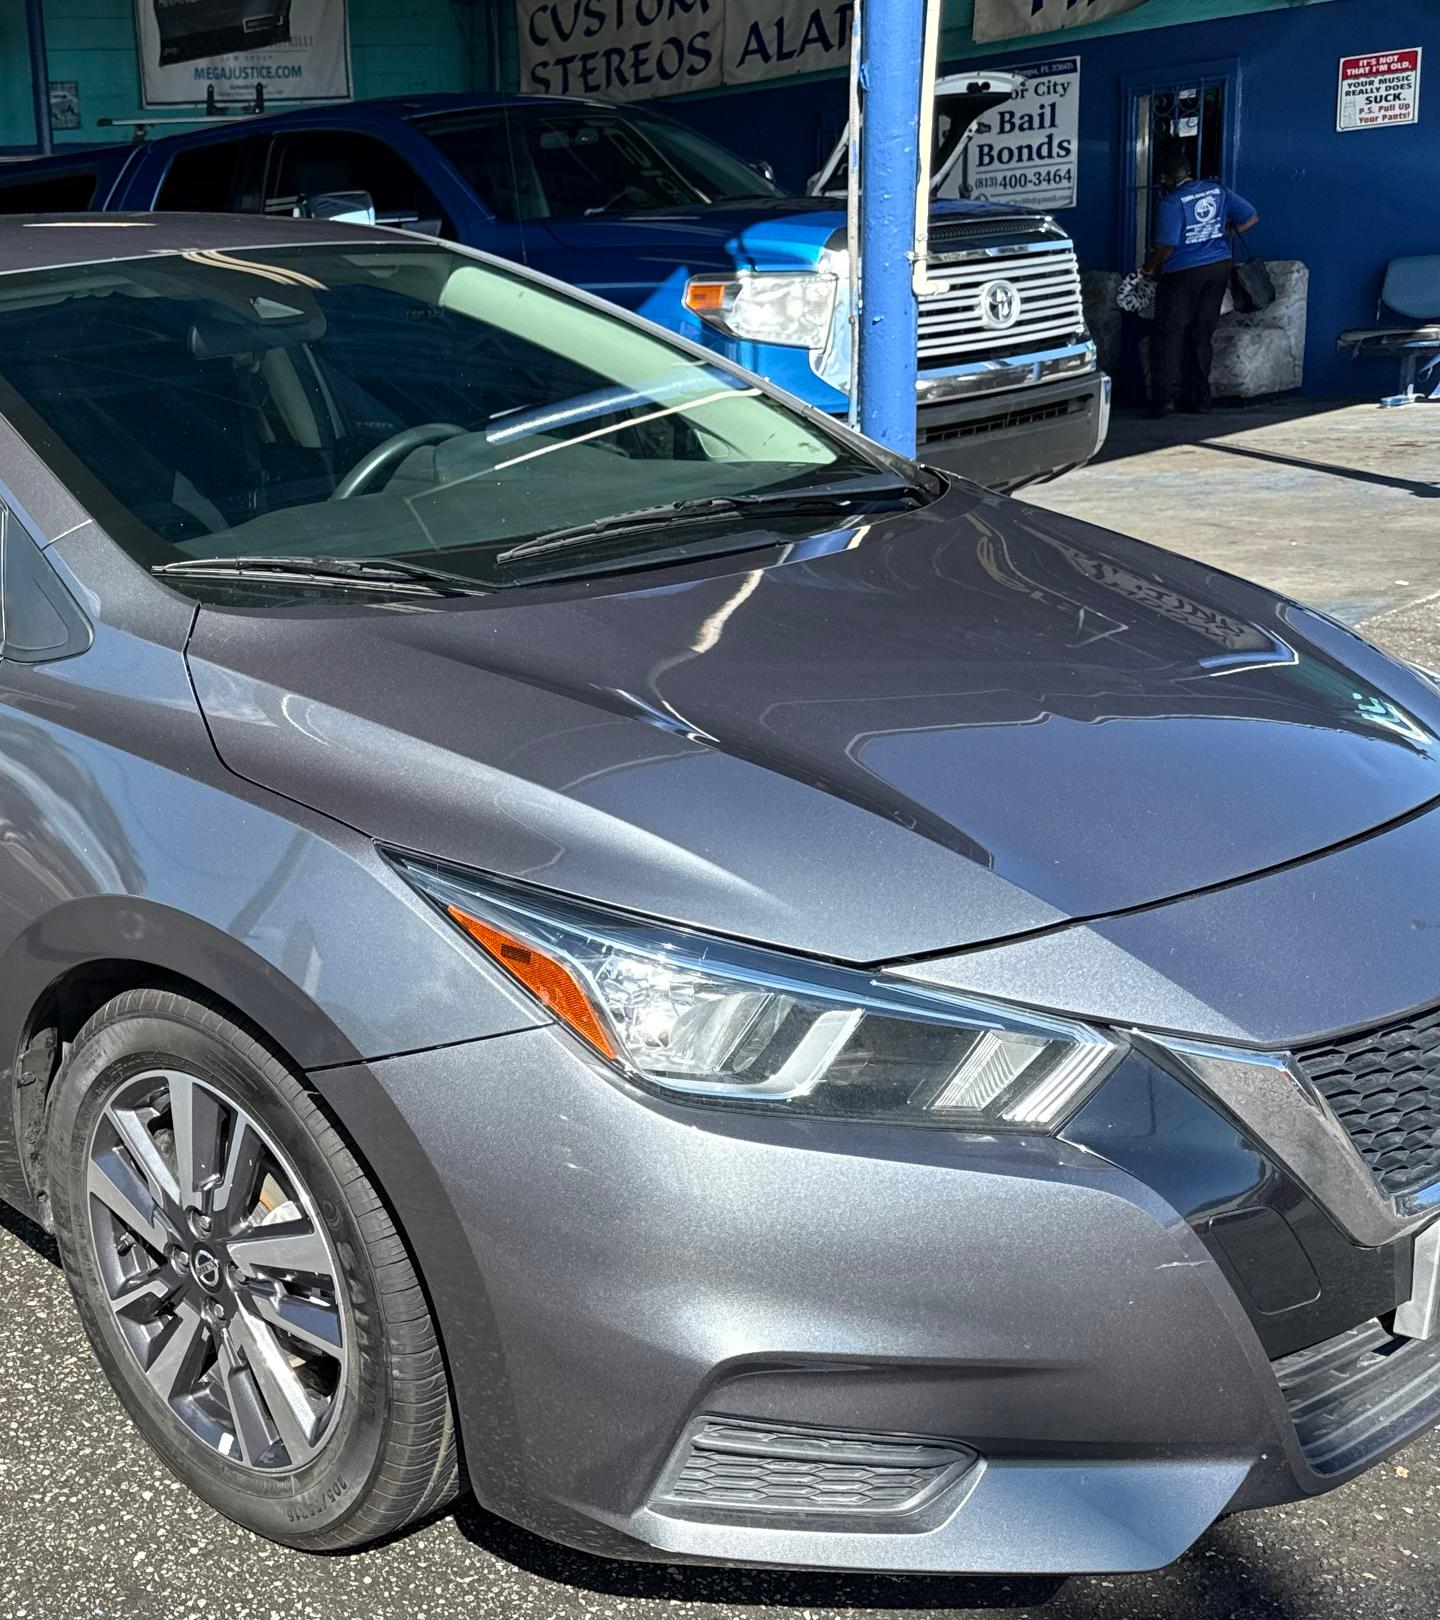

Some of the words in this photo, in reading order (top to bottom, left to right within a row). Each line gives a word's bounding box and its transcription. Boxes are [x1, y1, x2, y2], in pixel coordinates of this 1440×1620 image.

[530, 31, 713, 94] STEREOS
[1359, 58, 1377, 67] IT'S
[1379, 55, 1399, 64] NOT
[194, 65, 303, 81] MEGAJUSTICE.COM
[1347, 67, 1370, 76] THAT
[1034, 80, 1071, 97] City
[1345, 86, 1381, 97] REALLY
[1384, 82, 1412, 92] DOES
[1347, 80, 1375, 89] YOUR
[1379, 75, 1412, 85] MUSIC
[1365, 92, 1407, 105] SUCK.
[1378, 104, 1395, 112] Pull
[1398, 103, 1410, 112] Up
[997, 102, 1058, 135] Bail
[1359, 115, 1379, 124] Your
[1382, 111, 1410, 121] Pants!
[976, 133, 1072, 168] Bonds
[975, 176, 998, 190] (813)
[998, 168, 1073, 190] 400-3464
